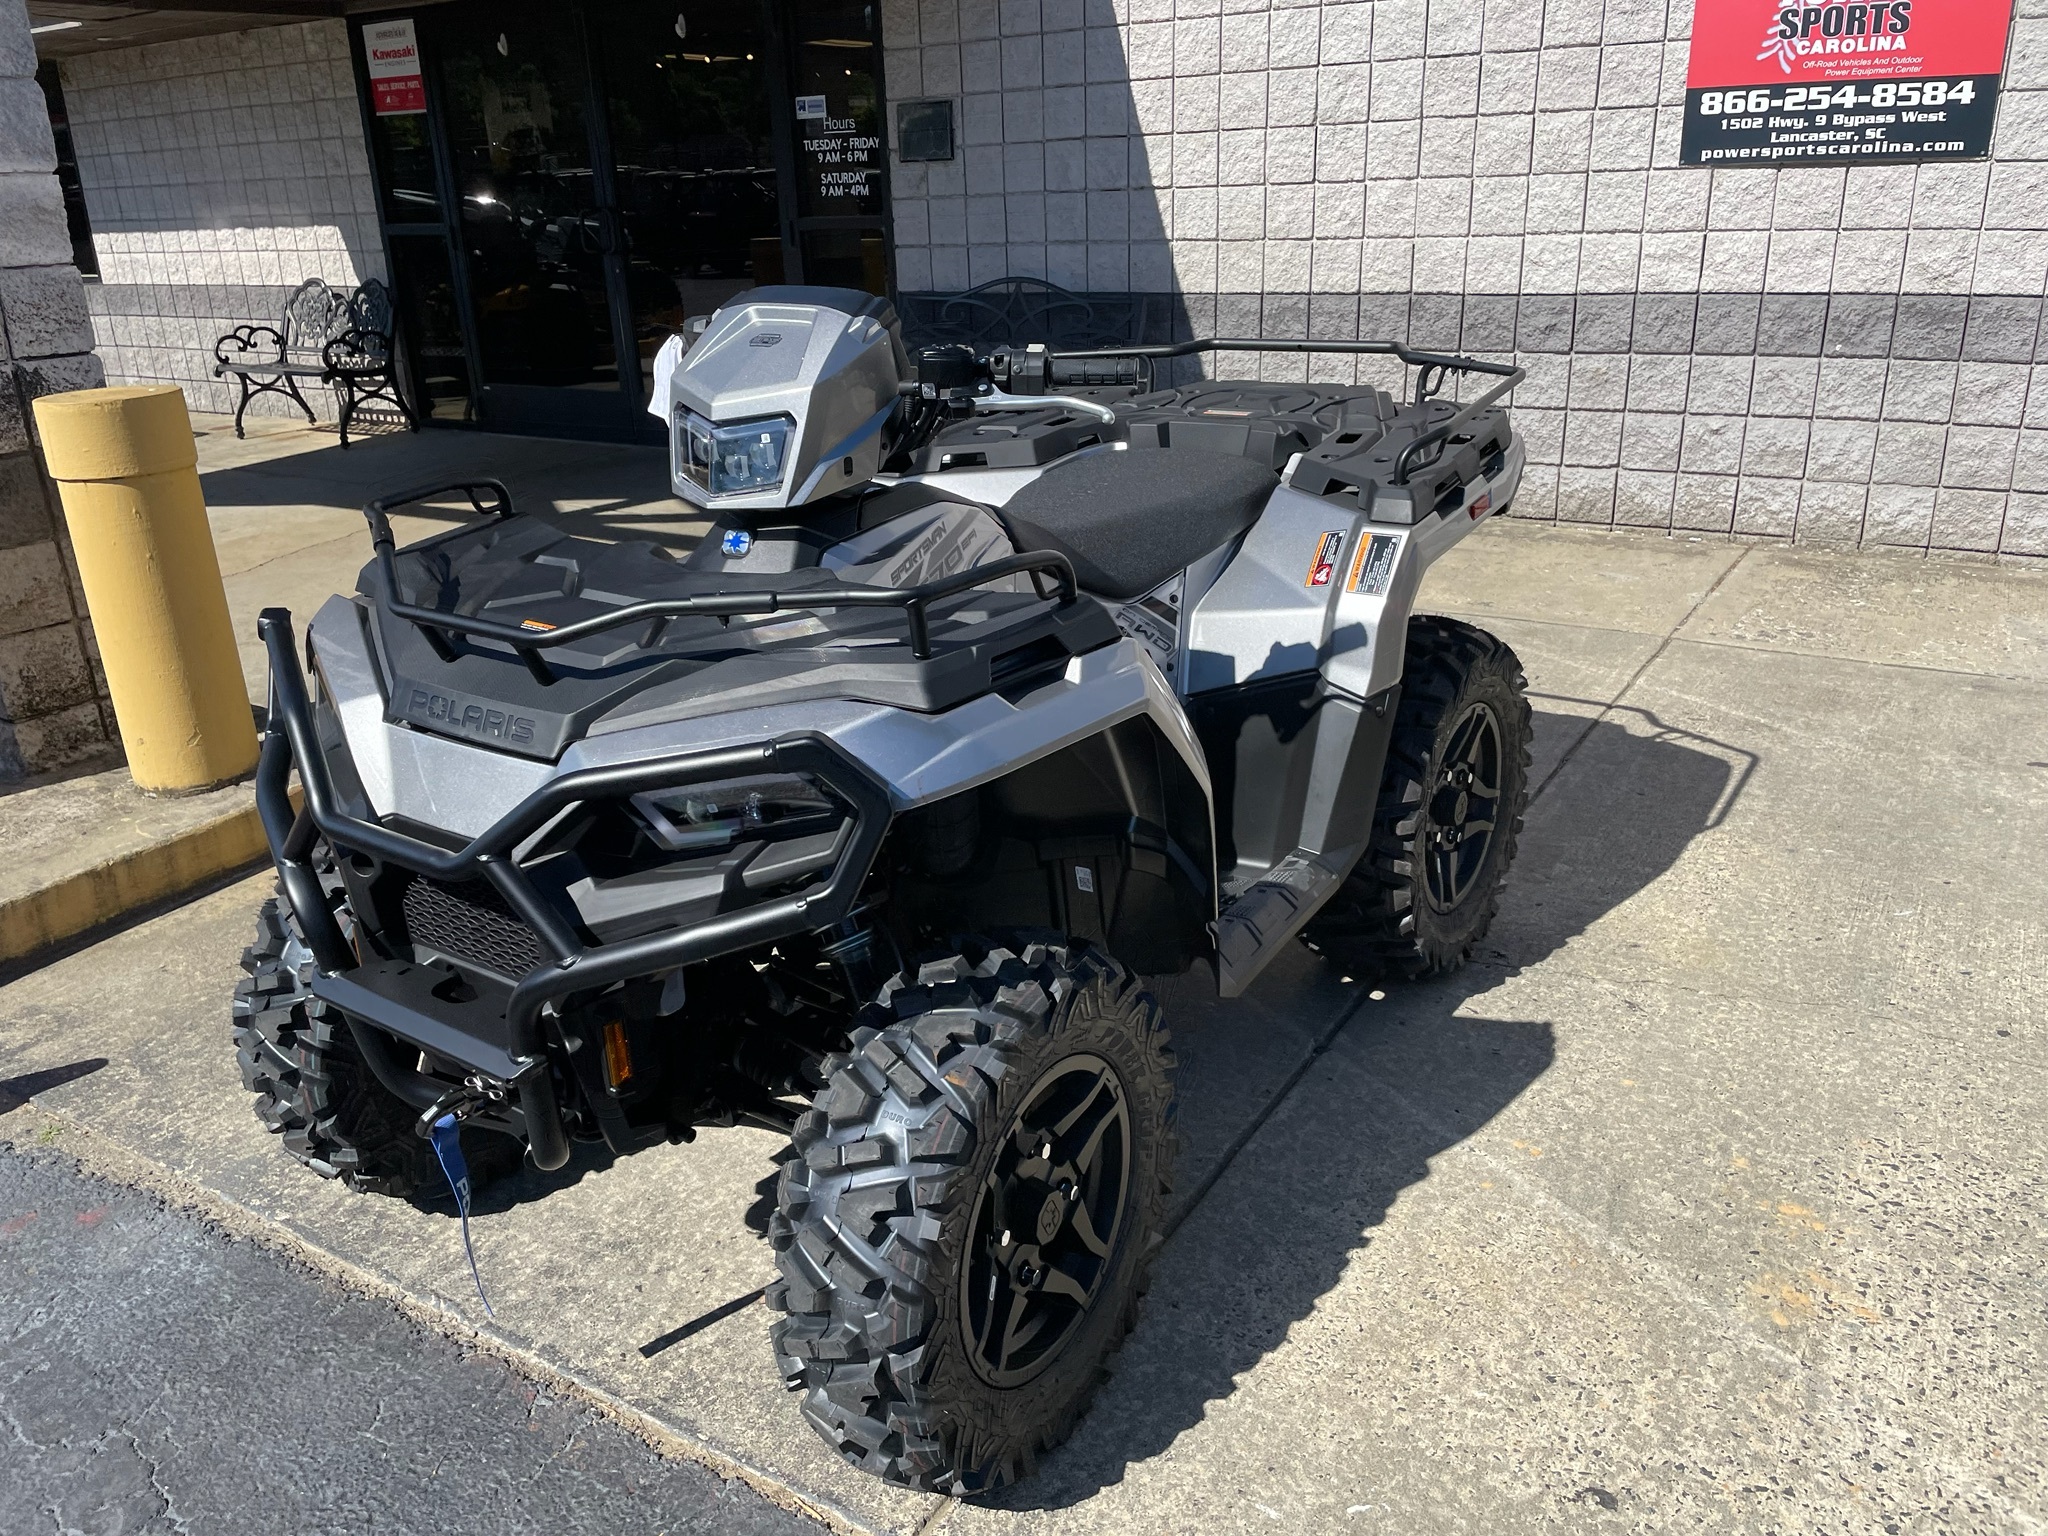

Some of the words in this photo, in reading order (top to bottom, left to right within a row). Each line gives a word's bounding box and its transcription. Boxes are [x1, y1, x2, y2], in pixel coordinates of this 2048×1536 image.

[1778, 1, 1911, 40] SPORTS
[372, 45, 415, 60] Kawasaki
[1796, 35, 1907, 56] CAROLINA
[1802, 60, 1838, 69] Off-Road
[1839, 58, 1872, 67] Vehicles
[1873, 57, 1890, 65] And
[1891, 55, 1924, 65] Outdoor
[1824, 68, 1850, 77] Power
[1851, 67, 1894, 77] Equipment
[1894, 65, 1923, 74] Center
[1700, 79, 1976, 116] 866-254-8584
[823, 117, 856, 130] Hours
[1720, 117, 1763, 130] 1502
[1768, 116, 1809, 130] Hwy.
[1814, 114, 1827, 126] 9
[1832, 112, 1896, 129] Bypass
[1901, 110, 1947, 123] West
[803, 138, 842, 151] TUESDAY
[850, 137, 880, 150] FRIDAY
[1770, 129, 1859, 144] Lancaster,
[1864, 128, 1887, 140] SC
[818, 153, 823, 163] 9
[825, 152, 840, 162] AM
[847, 151, 853, 162] 6
[854, 150, 868, 162] PM
[1700, 139, 1965, 162] powersportscarolina.com
[821, 172, 867, 184] SATURDAY
[820, 186, 826, 196] 9
[828, 185, 844, 196] AM
[960, 528, 978, 550] EFI
[890, 520, 947, 586] SPORTSMAN
[1355, 546, 1366, 571] WARNING
[1115, 612, 1172, 652] AWD
[408, 689, 536, 744] POLARIS
[881, 1110, 912, 1126] DURO
